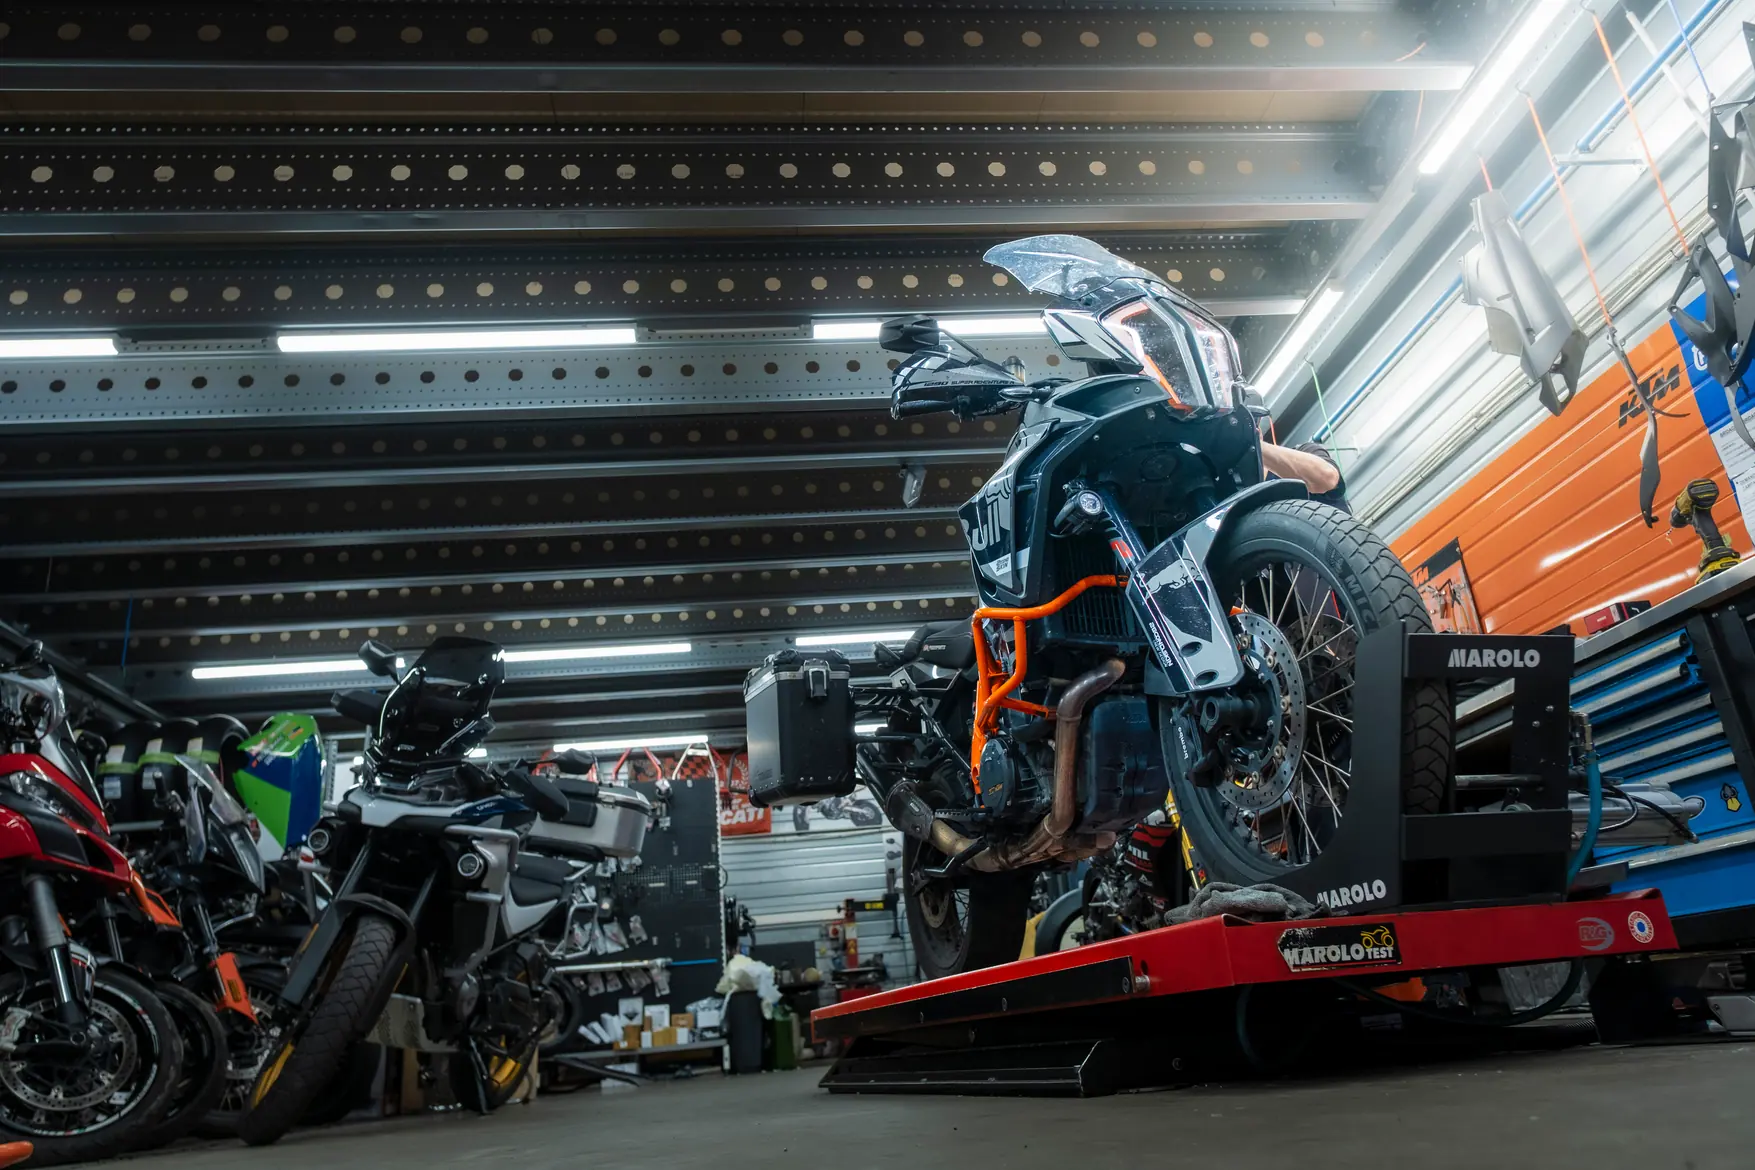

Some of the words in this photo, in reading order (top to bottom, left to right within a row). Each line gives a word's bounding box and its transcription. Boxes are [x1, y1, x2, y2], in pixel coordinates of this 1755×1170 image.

[951, 379, 974, 387] SUPER
[1618, 364, 1680, 429] KTM
[1409, 565, 1430, 588] TM
[1447, 648, 1541, 668] MAROLO
[1177, 726, 1189, 760] brembo
[719, 807, 765, 826] CATI
[1316, 879, 1387, 909] MAROLO
[1283, 943, 1365, 966] MAROLO
[1366, 946, 1394, 960] TEST
